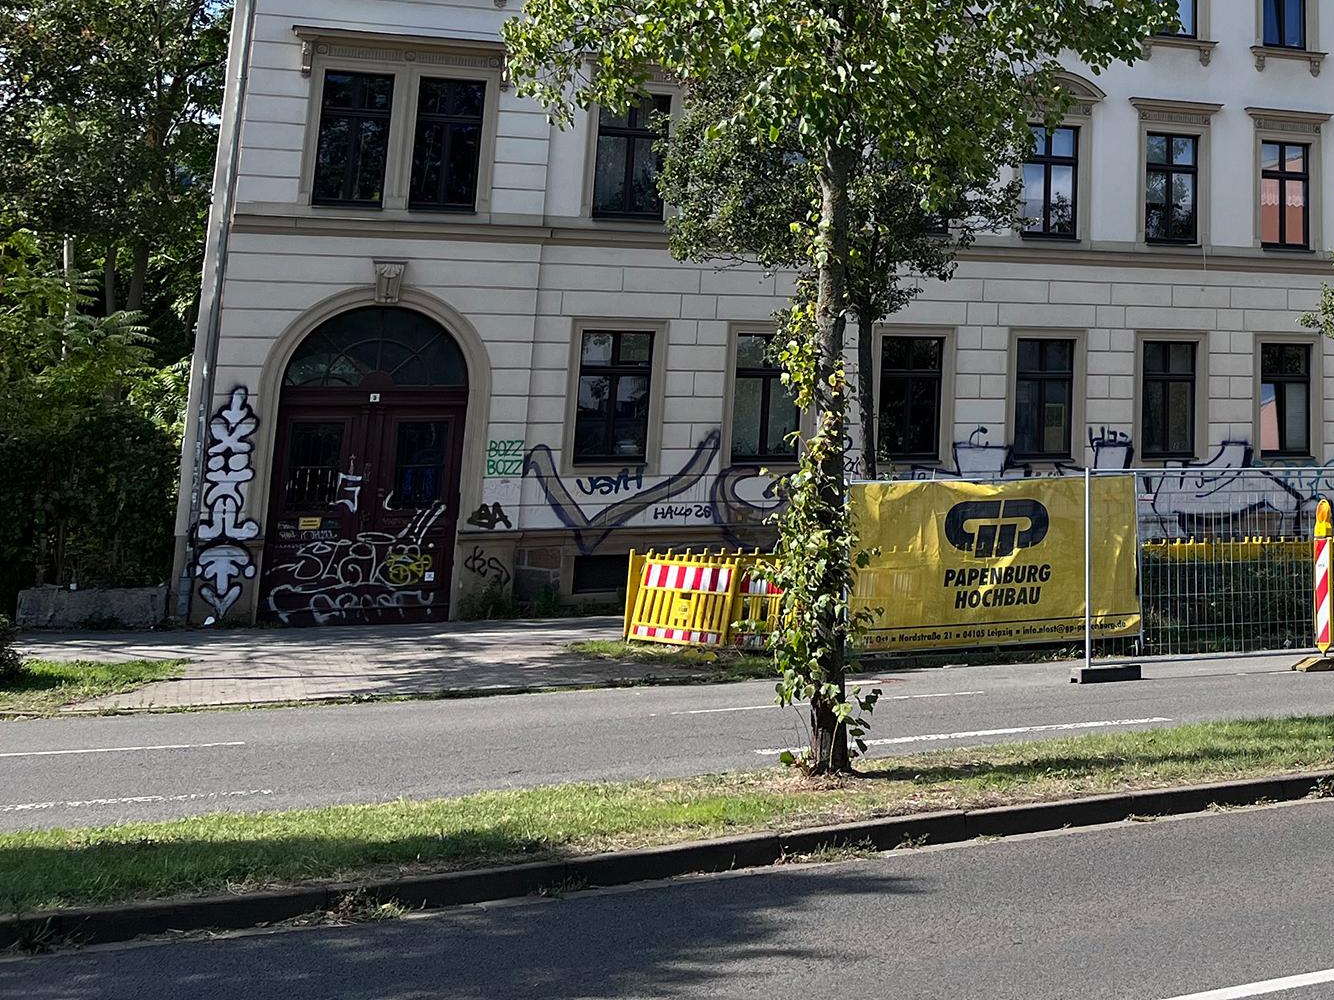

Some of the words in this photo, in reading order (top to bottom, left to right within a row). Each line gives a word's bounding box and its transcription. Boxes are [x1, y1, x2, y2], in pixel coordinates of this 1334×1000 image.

[489, 440, 524, 457] BOZZ
[487, 459, 523, 475] BOZZ
[944, 564, 1051, 587] PAPENBURG
[955, 586, 1041, 609] HOCHBAU
[899, 633, 941, 642] Nordstraße
[943, 631, 952, 640] 21
[962, 629, 985, 639] 04105
[987, 627, 1013, 637] Leipzig
